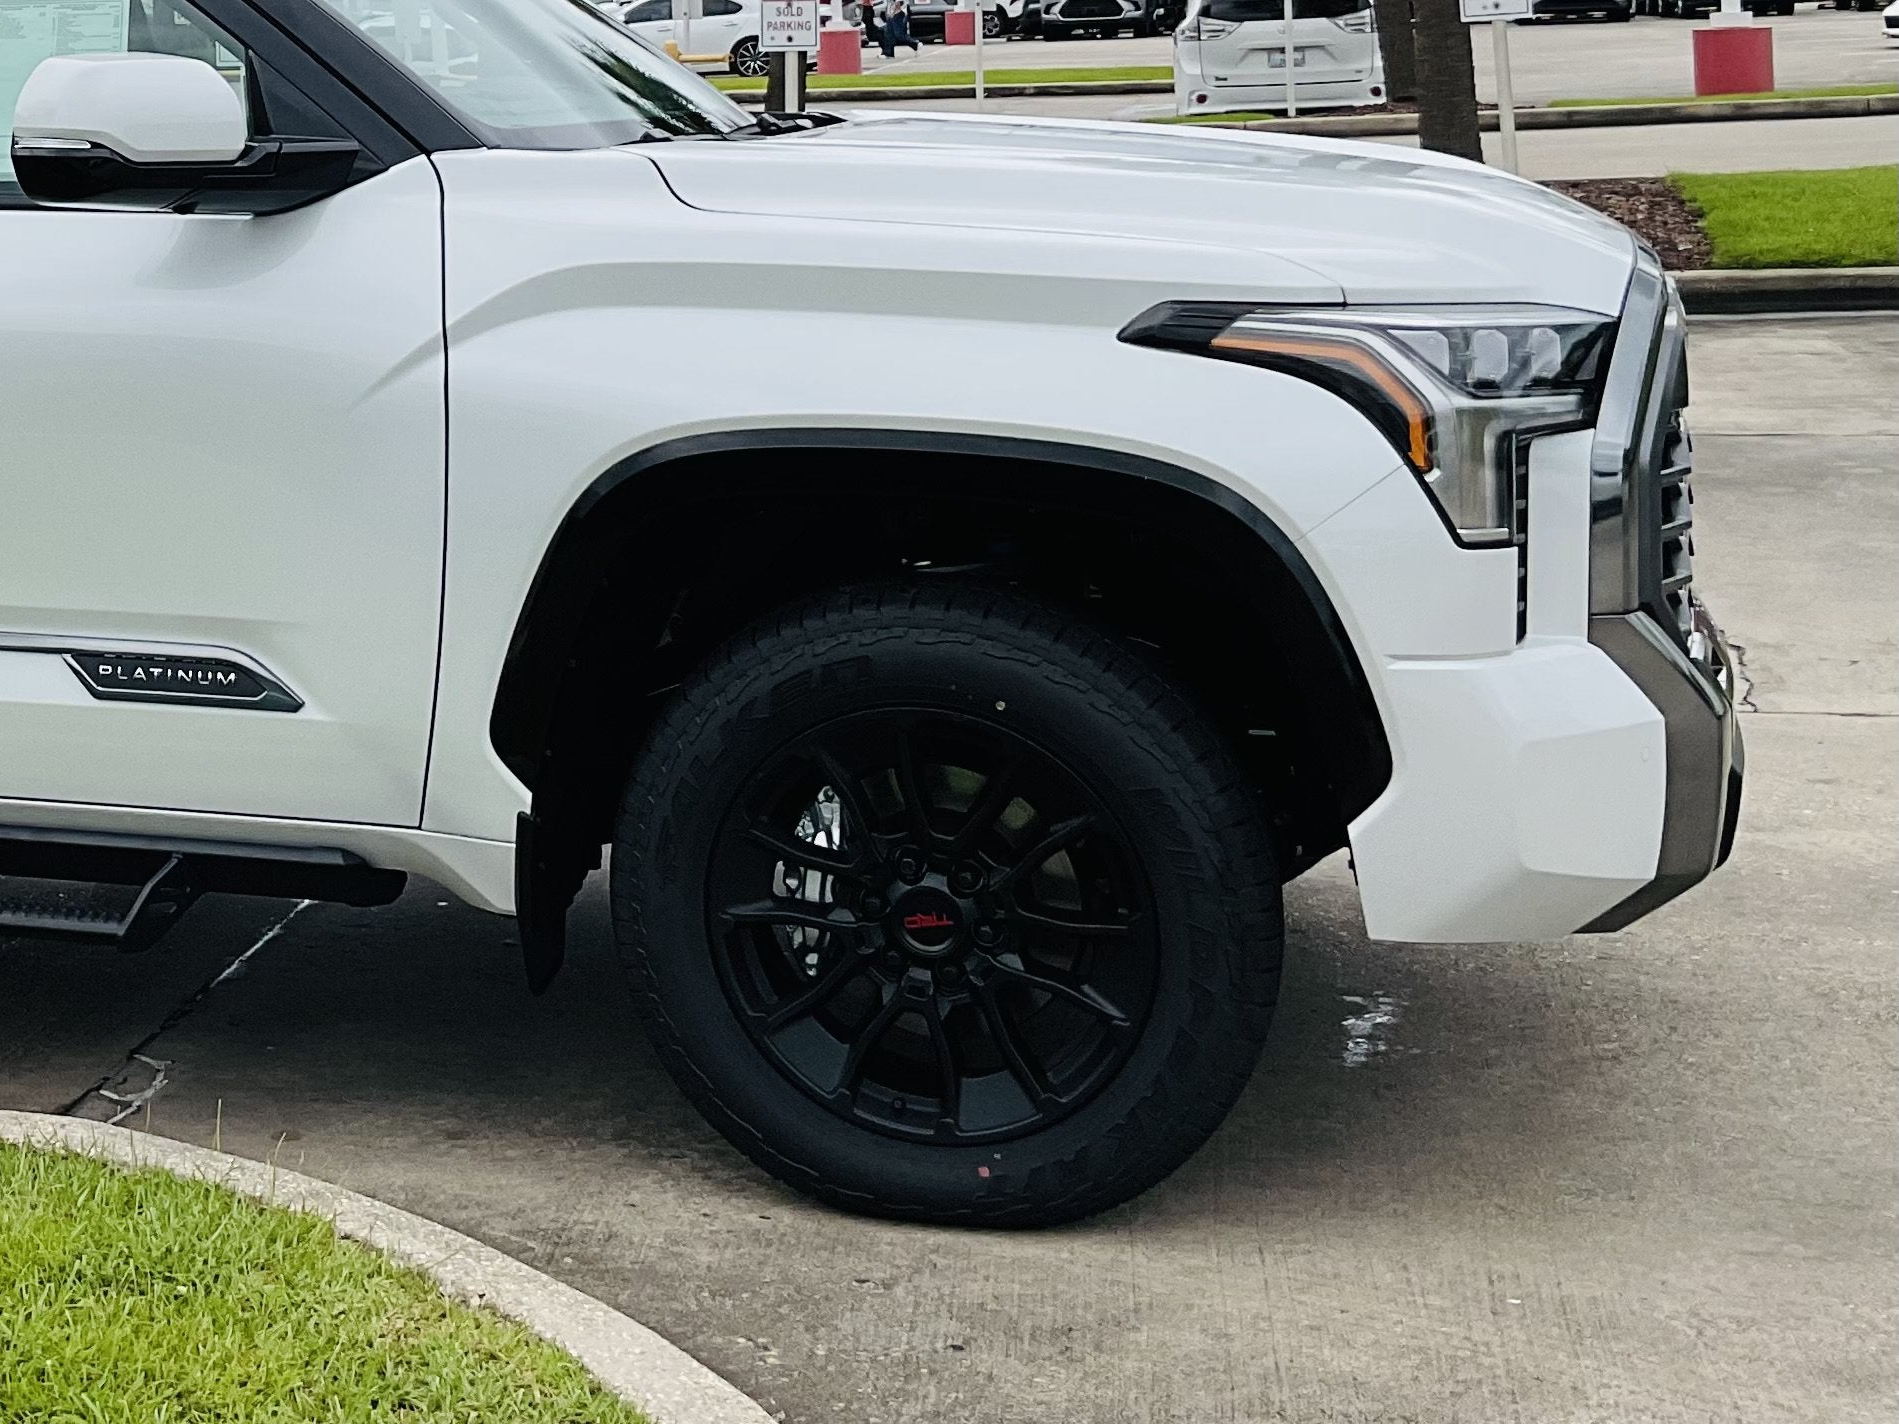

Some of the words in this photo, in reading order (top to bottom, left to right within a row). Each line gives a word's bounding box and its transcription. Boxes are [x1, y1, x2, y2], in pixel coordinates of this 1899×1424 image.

[775, 6, 804, 17] SOLD
[766, 21, 812, 31] PARKING
[98, 664, 237, 686] PLATINUM
